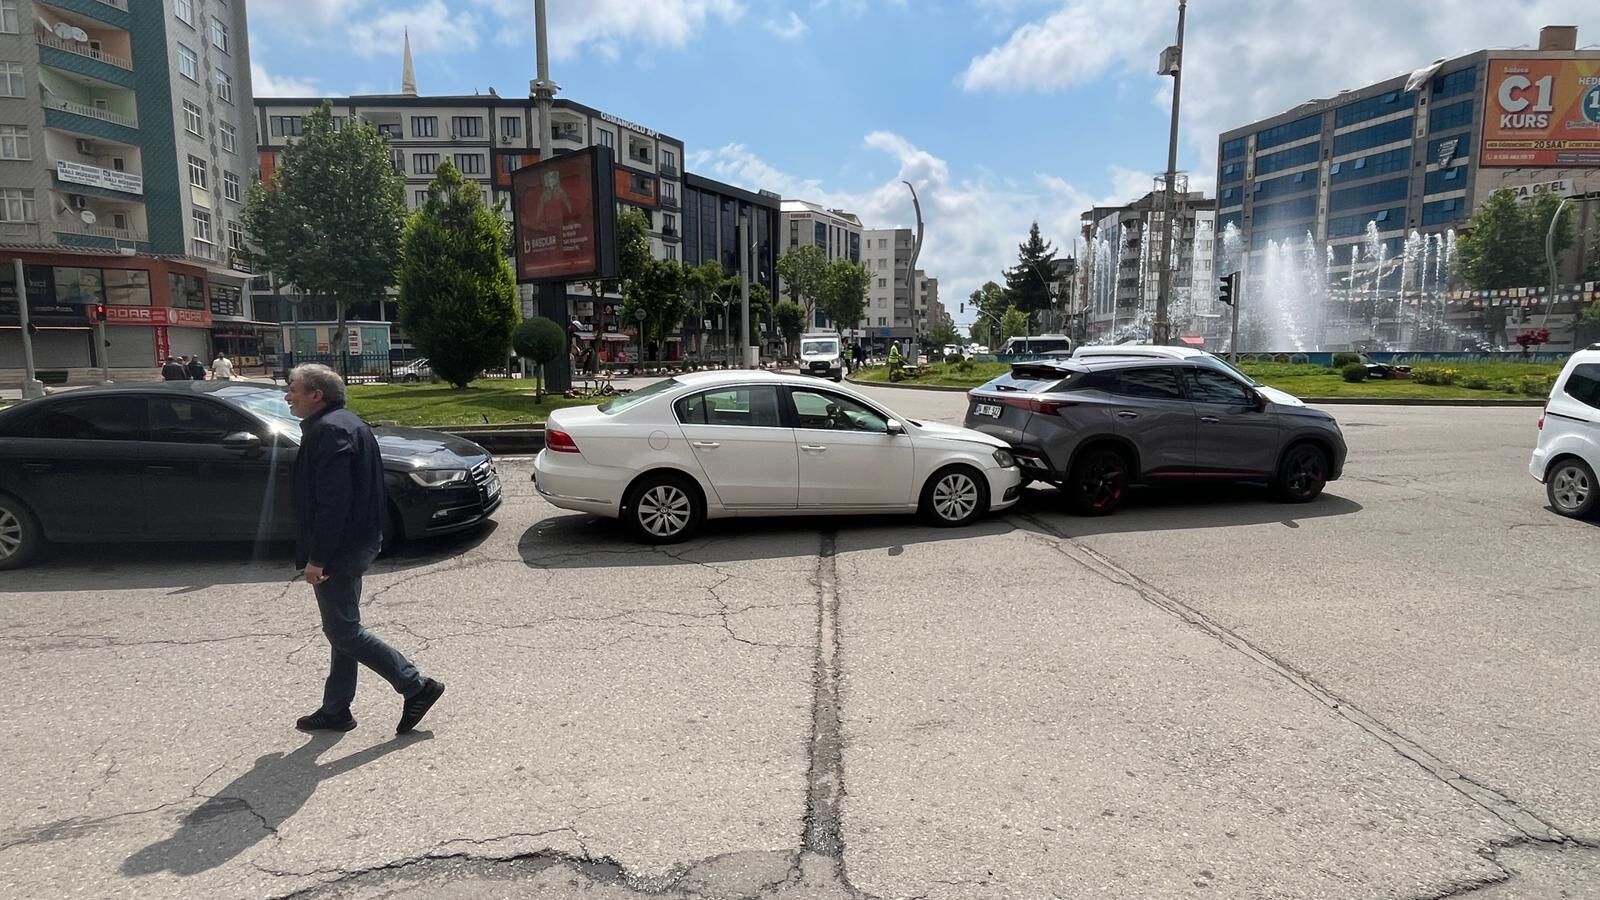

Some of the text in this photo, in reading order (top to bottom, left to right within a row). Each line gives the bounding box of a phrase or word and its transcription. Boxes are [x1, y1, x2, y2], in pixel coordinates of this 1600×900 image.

[1578, 77, 1600, 85] HED
[1498, 75, 1553, 112] C1
[1500, 114, 1548, 128] KURS
[1534, 141, 1545, 149] 20
[1546, 141, 1567, 149] SAAT
